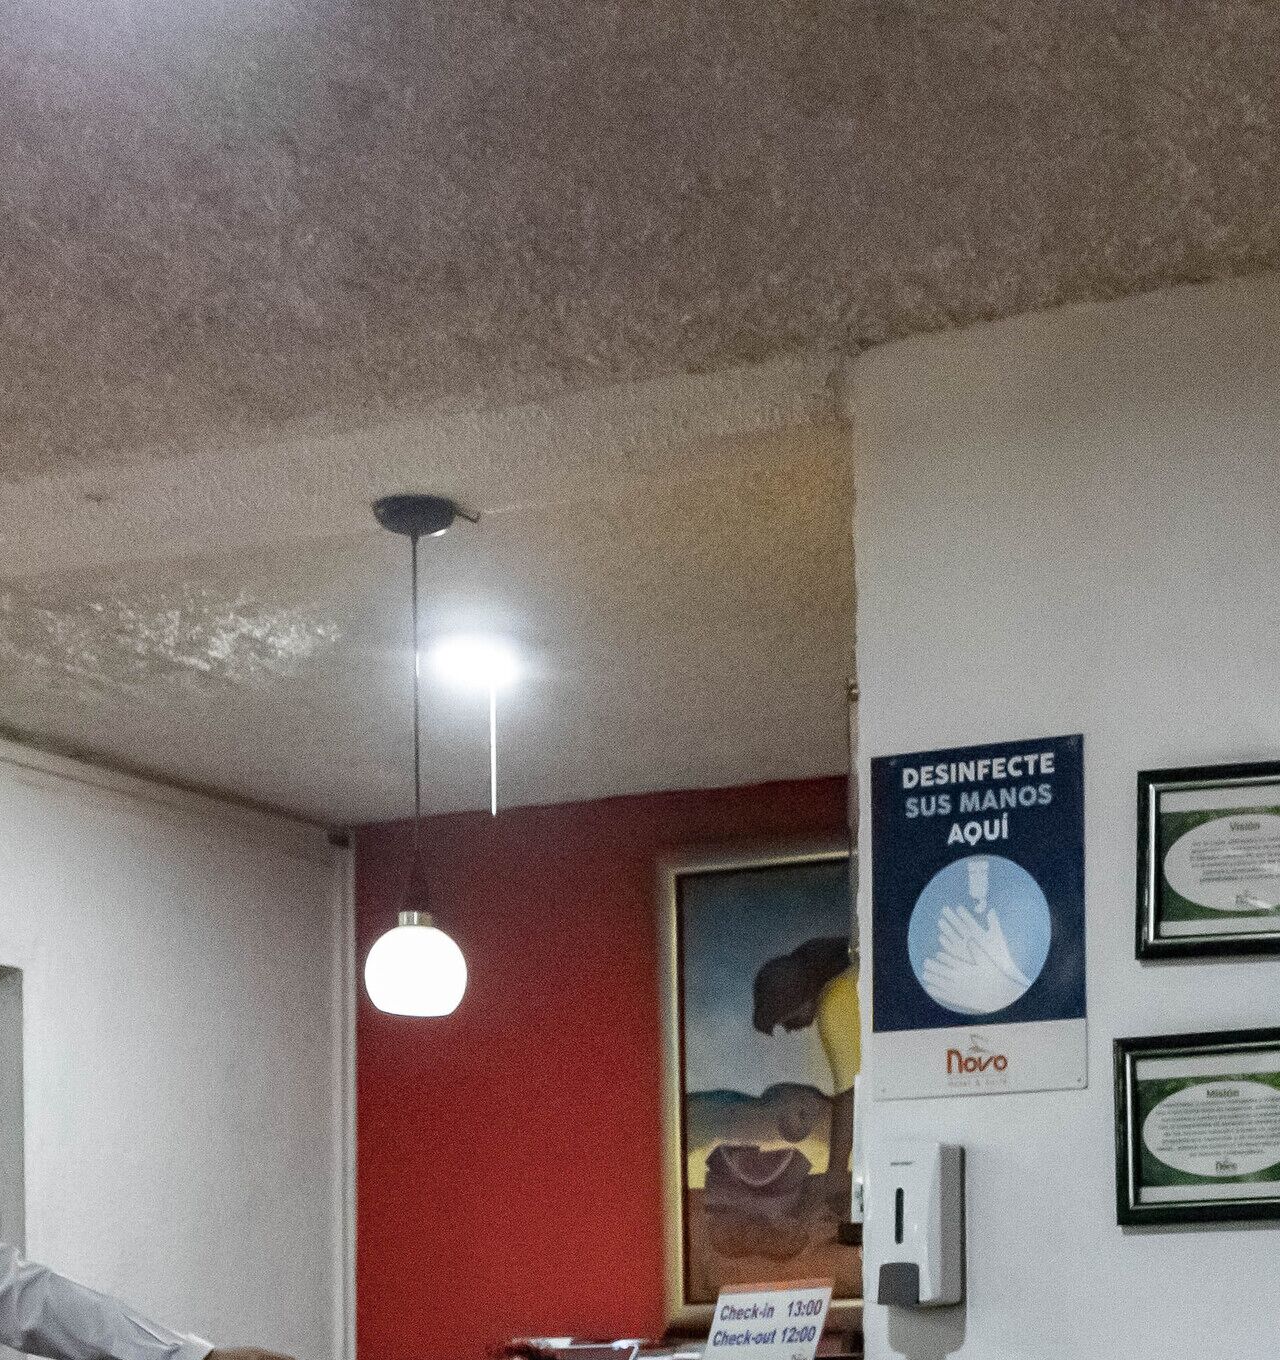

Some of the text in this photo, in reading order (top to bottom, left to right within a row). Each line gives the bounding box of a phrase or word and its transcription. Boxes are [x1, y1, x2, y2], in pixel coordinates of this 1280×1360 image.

[902, 752, 1055, 789] DESINFECTE
[905, 784, 1053, 819] SUS MANOS
[947, 812, 1009, 846] AQUÍ
[720, 1299, 823, 1321] Check-in 13:00
[712, 1325, 816, 1347] Check-out 12:00
